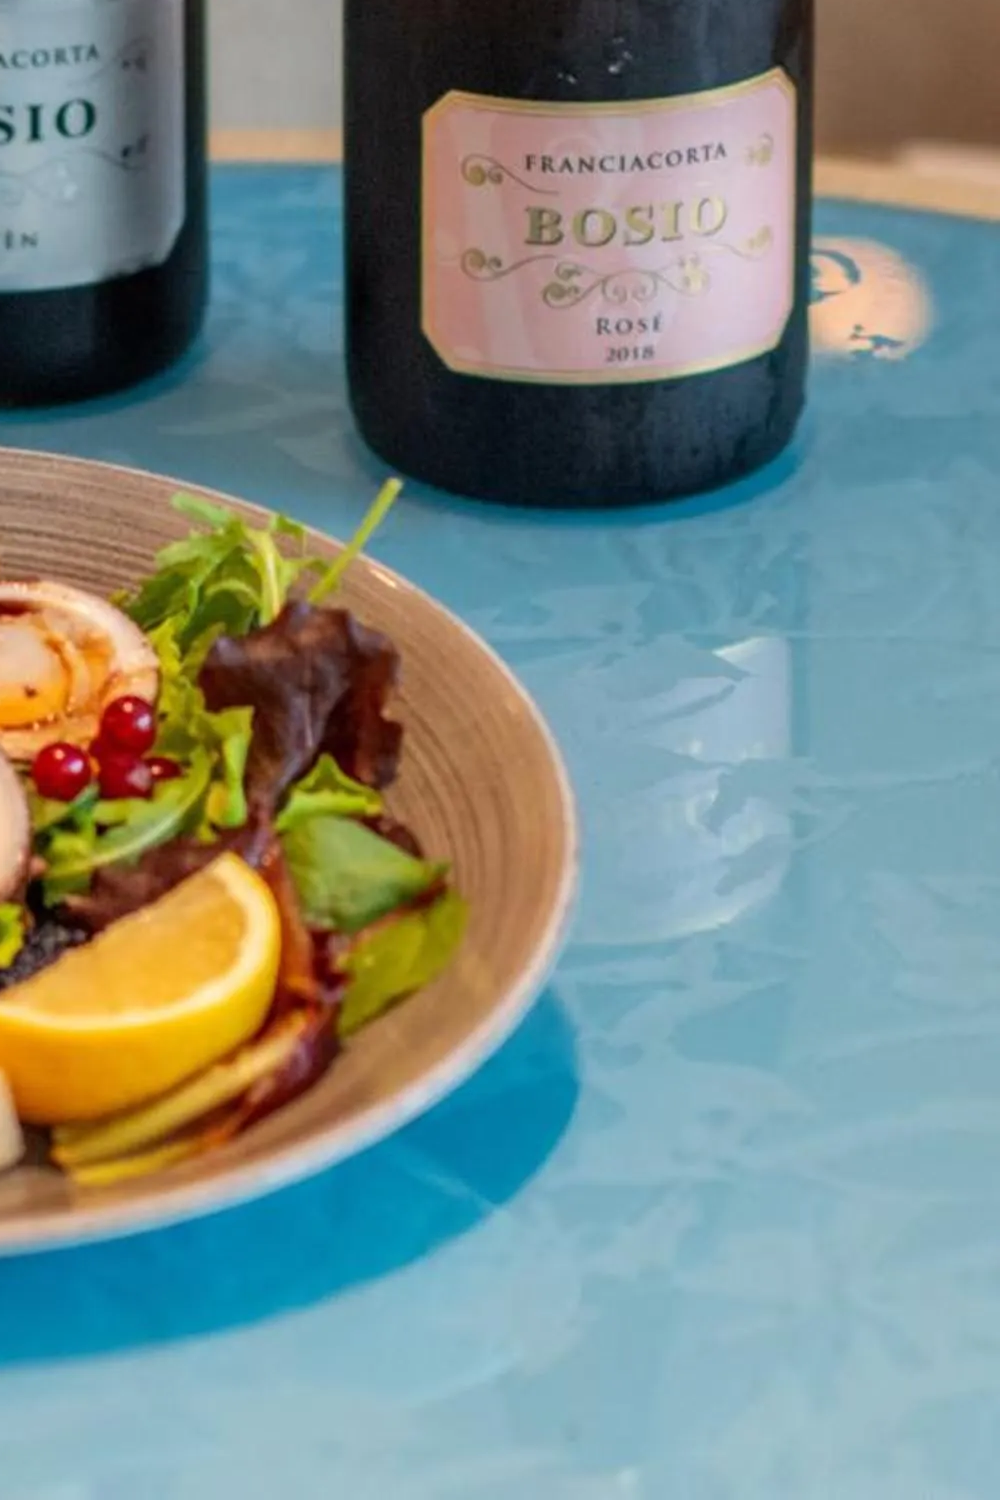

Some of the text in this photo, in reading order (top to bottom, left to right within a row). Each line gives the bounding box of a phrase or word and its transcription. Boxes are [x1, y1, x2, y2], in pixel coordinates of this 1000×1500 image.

[524, 141, 729, 175] FRANCIACORTA
[524, 196, 729, 248] BOSIO
[605, 345, 656, 363] 2018
